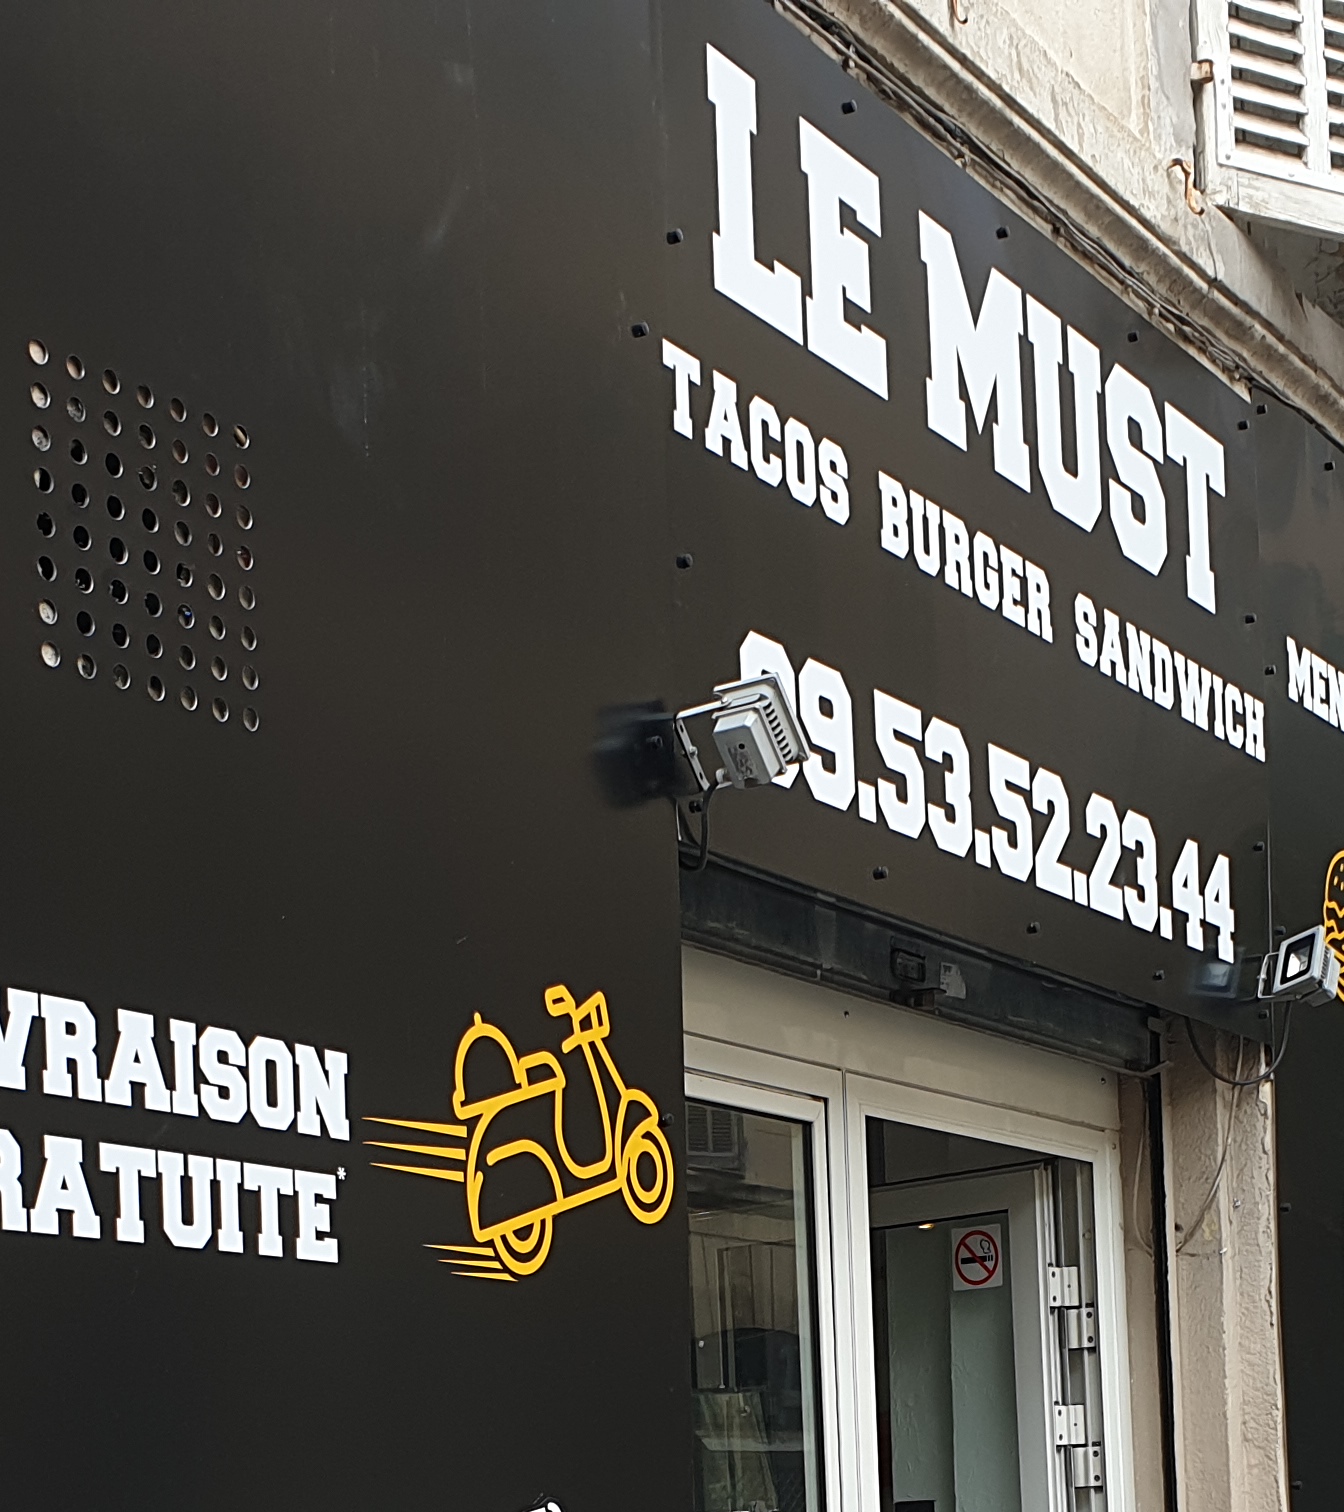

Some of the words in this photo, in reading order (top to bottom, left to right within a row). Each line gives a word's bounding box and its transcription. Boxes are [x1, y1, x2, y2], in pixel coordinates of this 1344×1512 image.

[662, 338, 850, 526] TACOS
[878, 470, 1053, 644] BURGER
[1074, 592, 1266, 763] SANDWICH
[706, 42, 889, 401] LE
[918, 209, 1226, 615] MUST
